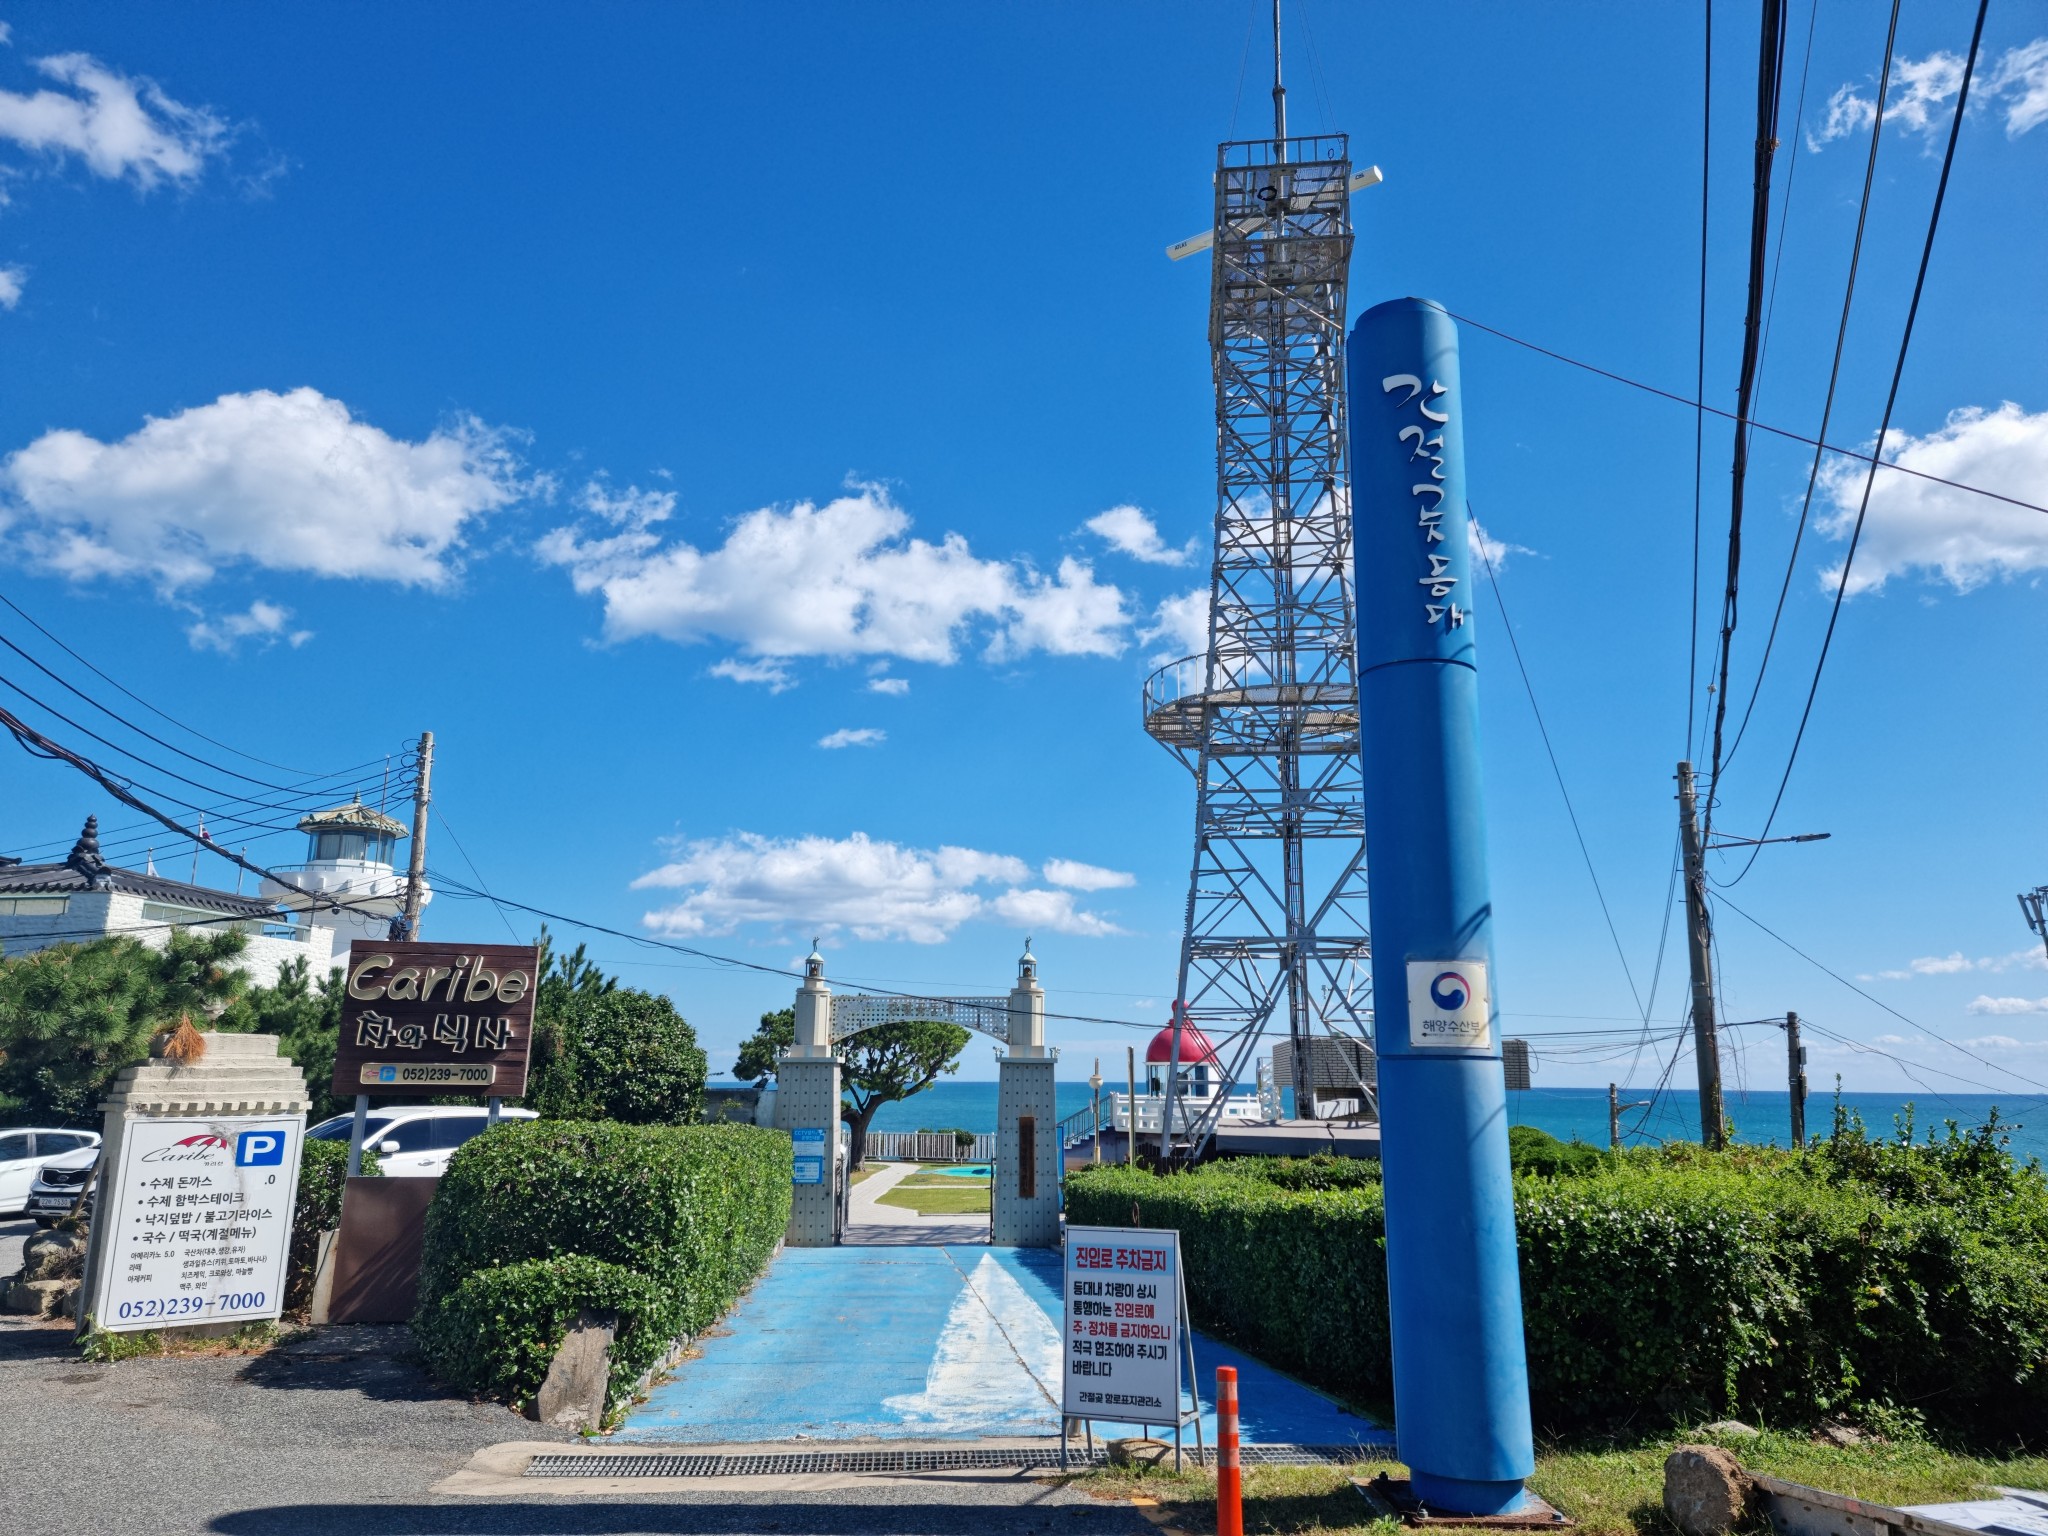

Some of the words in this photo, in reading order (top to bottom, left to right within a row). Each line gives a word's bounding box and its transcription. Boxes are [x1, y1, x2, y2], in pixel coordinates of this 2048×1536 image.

[349, 955, 528, 1003] Caribe
[1422, 1020, 1480, 1033] 해양수산부
[402, 1067, 488, 1081] 052)239-7000
[141, 1147, 216, 1163] Caribe
[243, 1136, 276, 1163] P
[149, 1177, 174, 1190] 수제
[177, 1175, 213, 1189] 돈까스
[146, 1194, 172, 1208] 수제
[174, 1192, 245, 1207] 함박스테이크
[145, 1212, 193, 1226] 낙지덮밥
[204, 1208, 273, 1224] 불고기라이스
[142, 1231, 167, 1245] 국수
[178, 1226, 257, 1243] 떡국(계절메뉴)
[130, 1250, 162, 1260] 아메리카노
[164, 1250, 175, 1258] 5.0
[1075, 1247, 1113, 1268] 진입로
[1116, 1249, 1166, 1271] 주차금지
[1073, 1281, 1102, 1296] 등대내
[1105, 1282, 1134, 1298] 차량이
[1136, 1284, 1157, 1299] 상시
[119, 1292, 265, 1318] 052)239-7000
[1073, 1300, 1112, 1316] 통행하는
[1115, 1303, 1155, 1319] 진입로에
[1120, 1323, 1170, 1340] 금지하오니
[1072, 1340, 1092, 1355] 적극
[1095, 1341, 1134, 1358] 협조하여
[1137, 1344, 1167, 1360] 주시기
[1072, 1360, 1112, 1377] 바랍니다
[1079, 1392, 1103, 1403] 간절곶
[1105, 1393, 1162, 1407] 항로표지관리소
